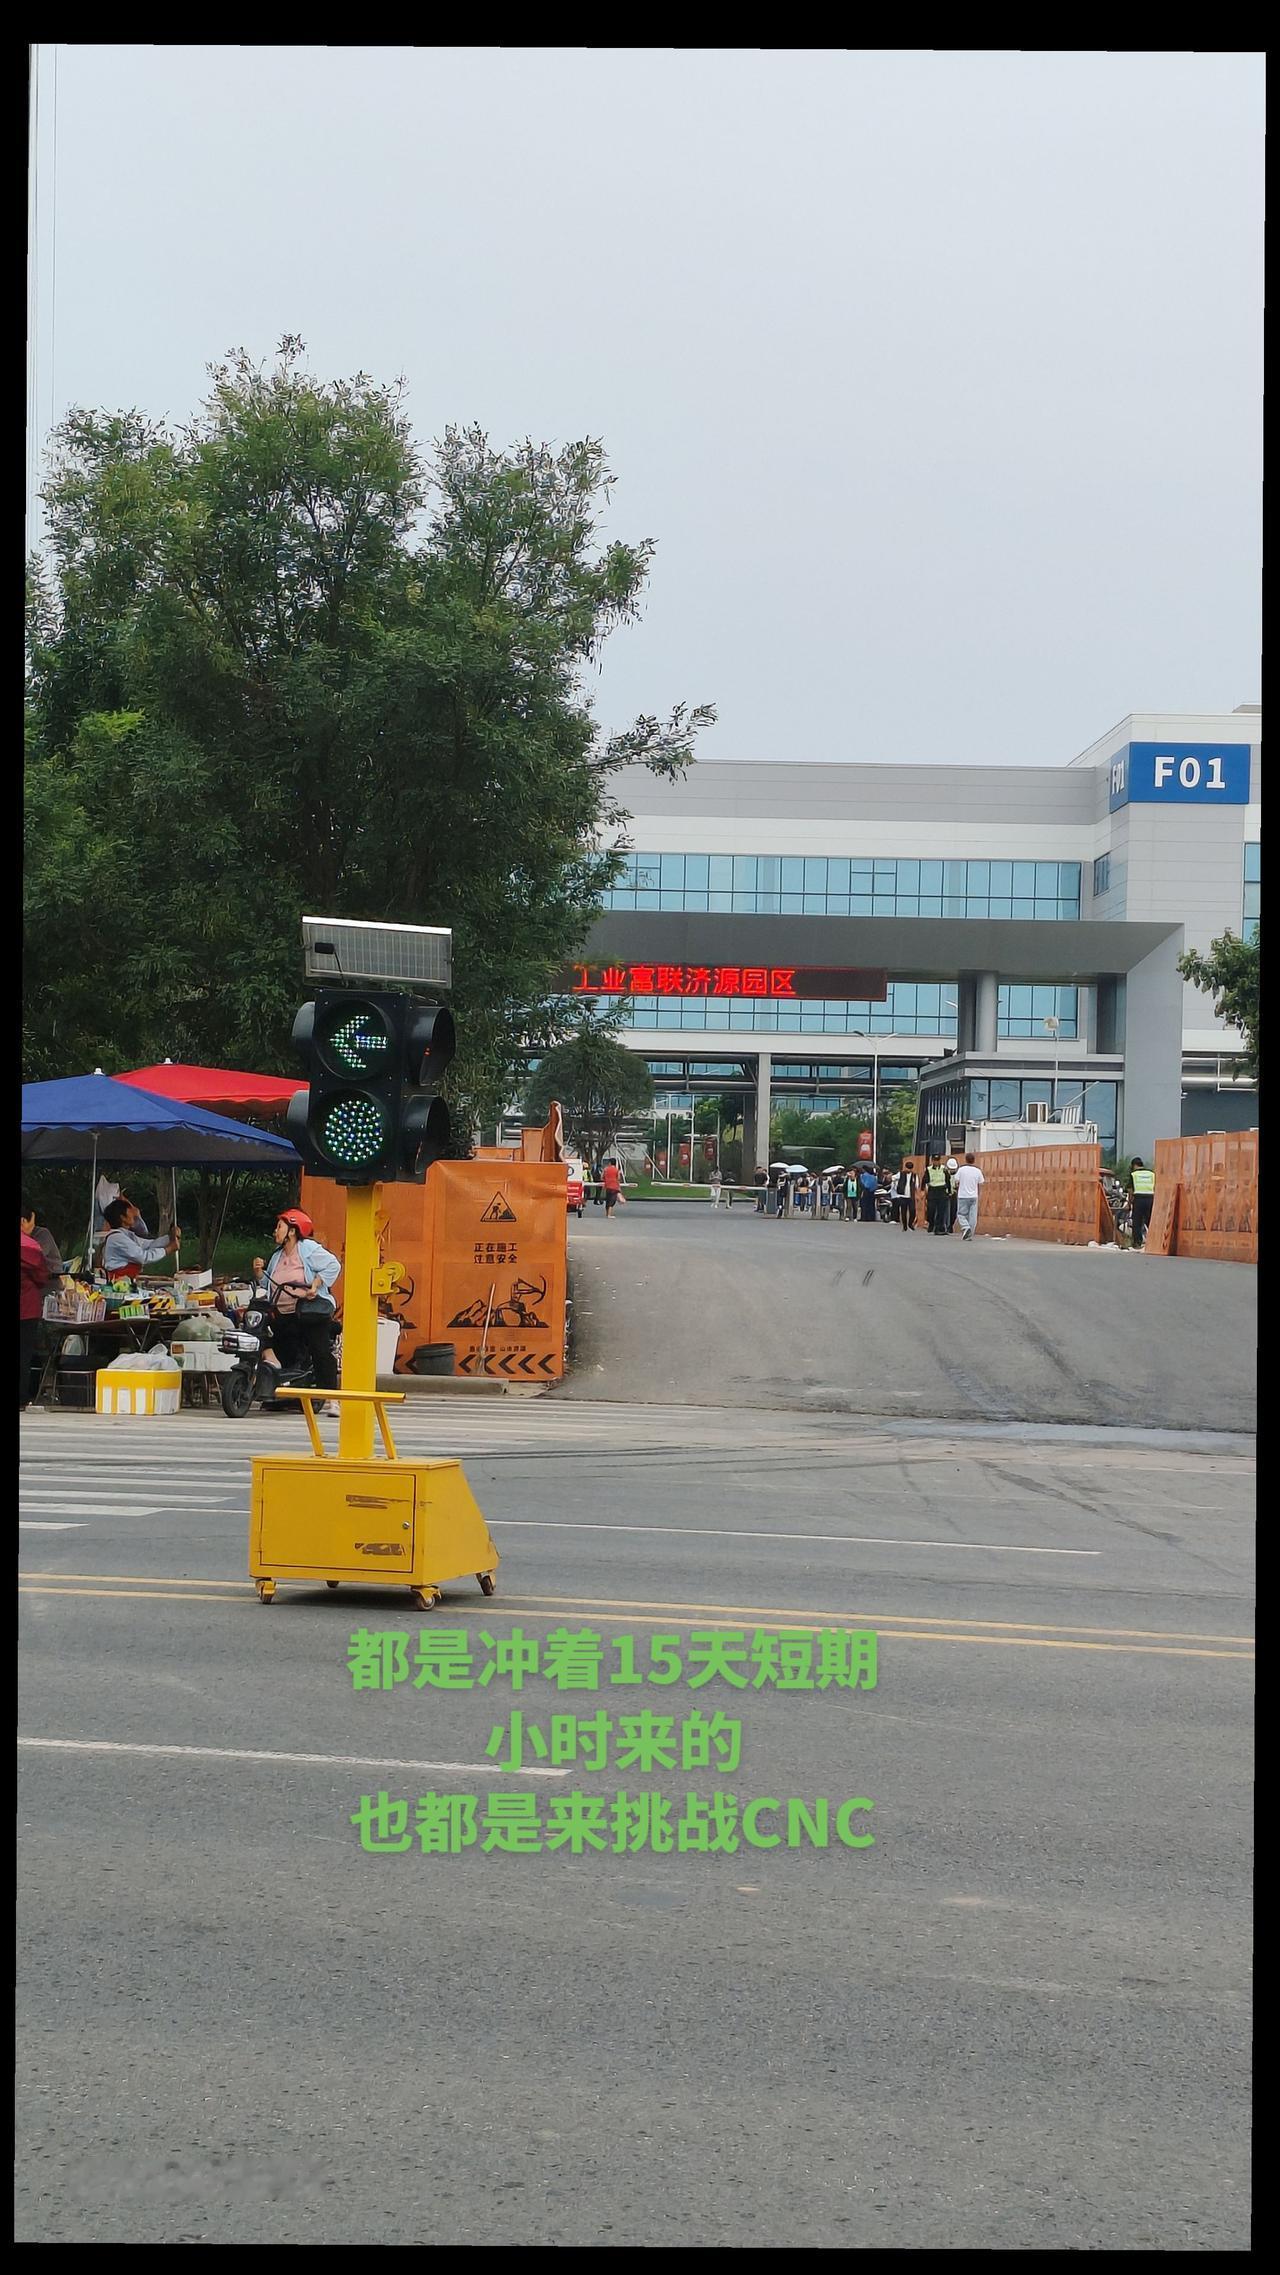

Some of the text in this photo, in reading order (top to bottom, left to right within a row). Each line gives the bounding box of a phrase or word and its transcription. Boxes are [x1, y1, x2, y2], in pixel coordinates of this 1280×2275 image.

[1154, 756, 1226, 789] F01
[573, 965, 796, 996] 工业富联济源园区
